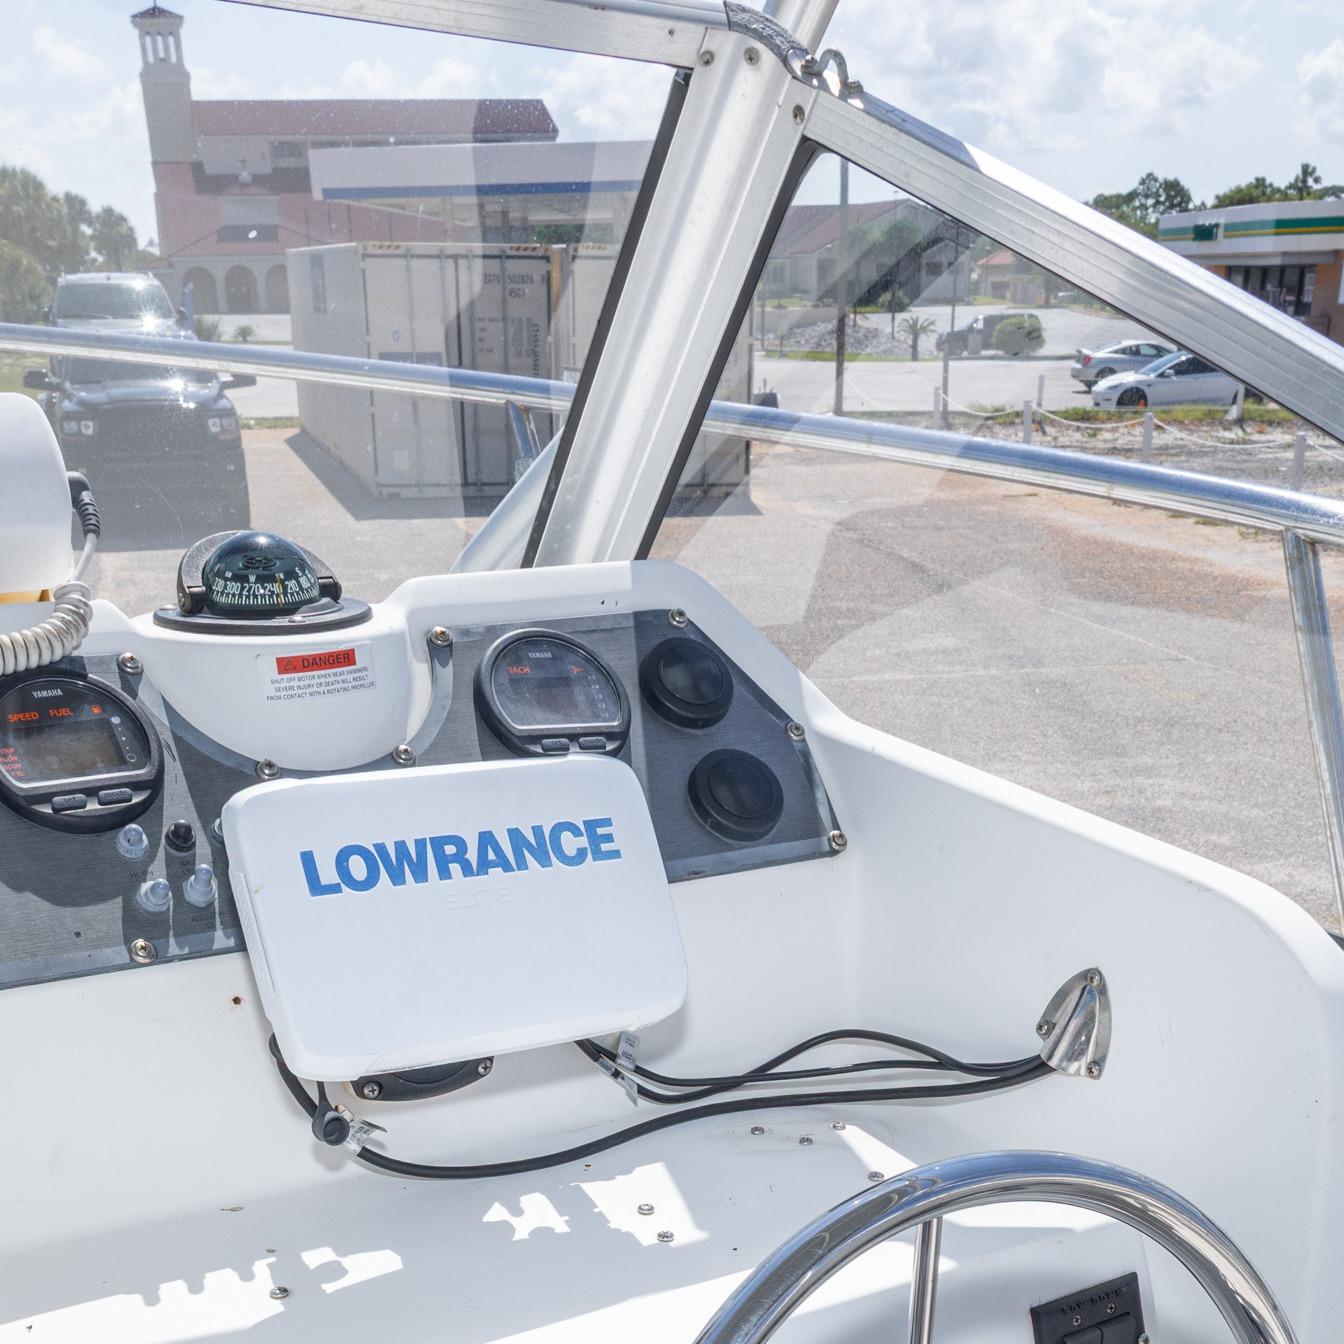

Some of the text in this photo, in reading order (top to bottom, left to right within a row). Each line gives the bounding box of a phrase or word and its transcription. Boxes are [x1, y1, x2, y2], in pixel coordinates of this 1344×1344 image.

[224, 581, 241, 595] 300
[242, 583, 261, 595] 270
[263, 582, 283, 595] 240
[285, 580, 300, 593] 210
[301, 652, 350, 669] DANGER
[270, 677, 285, 685] SHUT
[286, 676, 296, 684] OFF
[297, 674, 316, 682] MOTOR
[346, 666, 369, 675] SWIMMERS
[507, 665, 531, 674] TACH
[274, 685, 295, 694] SEVERE
[296, 683, 315, 691] INJURY
[323, 679, 341, 687] DEATH
[352, 674, 369, 683] RESULT
[31, 688, 64, 699] YAMAHA
[282, 692, 308, 701] CONTACT
[308, 690, 322, 698] WITH
[326, 686, 351, 695] ROTATING
[7, 707, 74, 723] SPEED FUEL
[103, 788, 130, 800] mode
[299, 817, 622, 898] LOWRANCE
